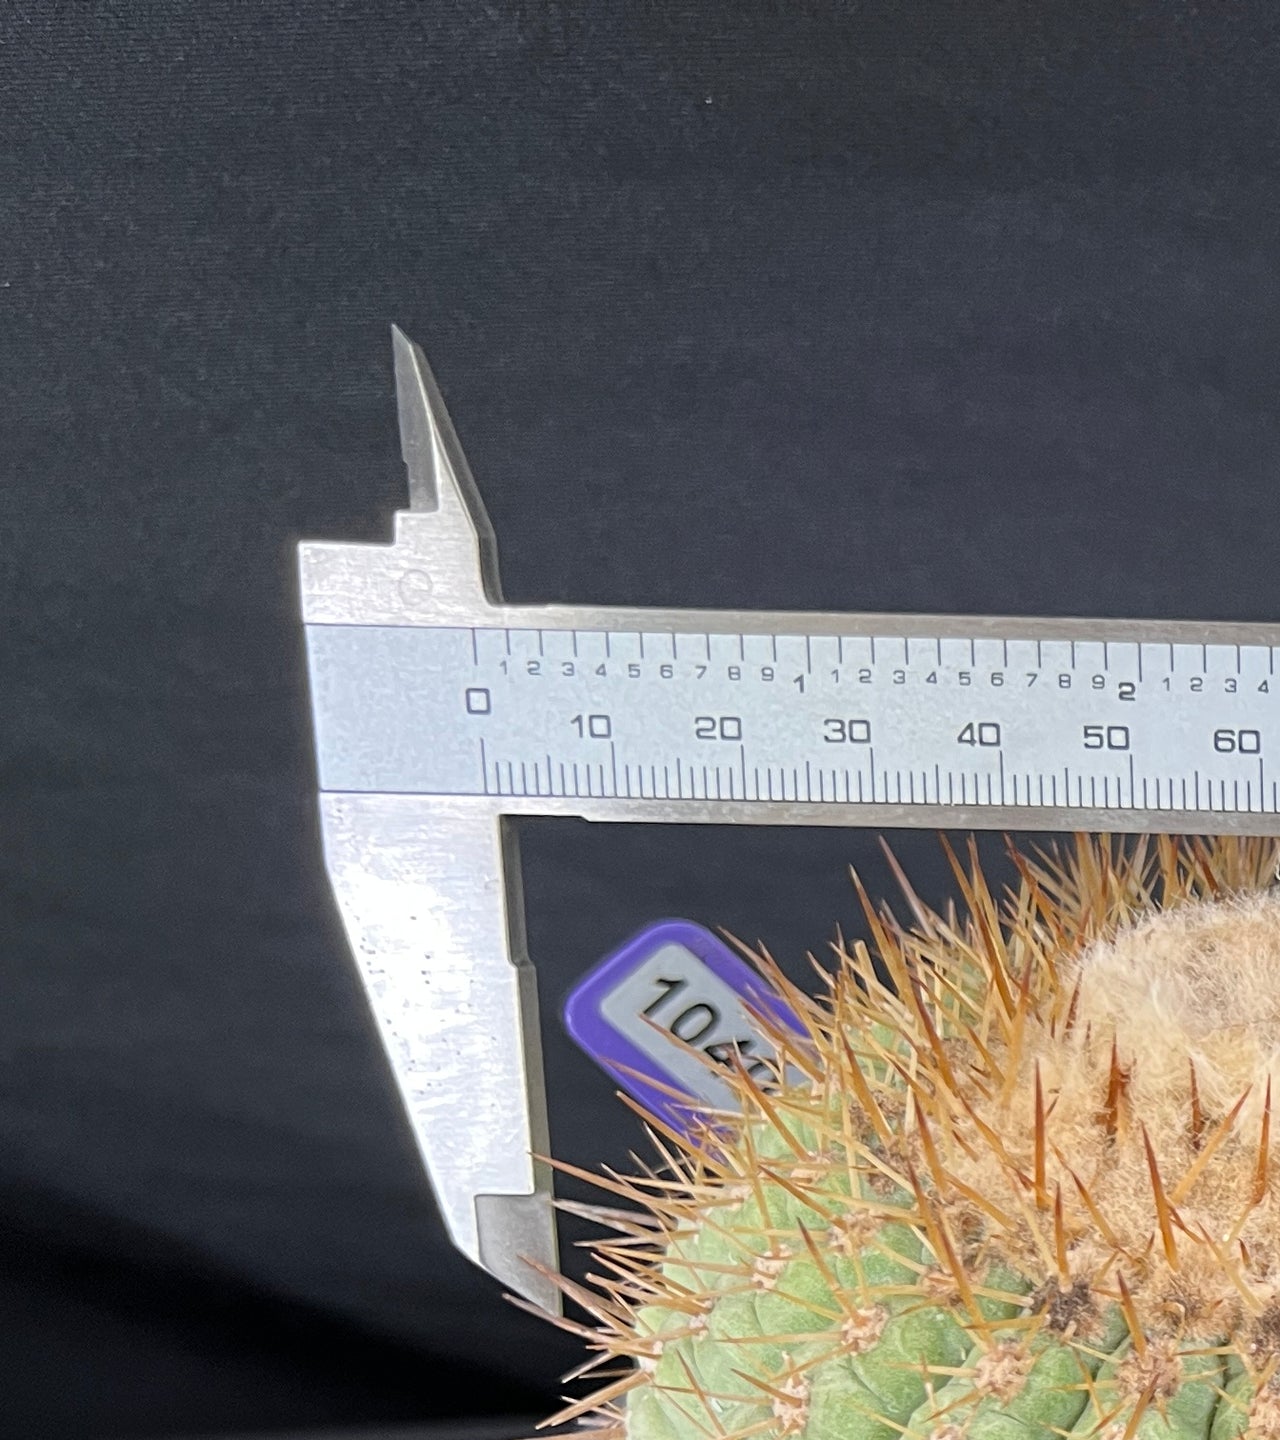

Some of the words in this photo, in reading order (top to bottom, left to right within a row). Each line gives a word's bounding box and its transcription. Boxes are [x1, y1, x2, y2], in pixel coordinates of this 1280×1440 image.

[499, 659, 508, 676] 1
[526, 660, 542, 676] 2
[561, 661, 575, 677] 3
[594, 663, 607, 678] 4
[627, 663, 641, 679] 5
[659, 664, 674, 680] 6
[695, 664, 708, 680] 7
[727, 665, 742, 681] 8
[760, 666, 775, 682] 9
[792, 673, 805, 694] 1
[830, 668, 839, 684] 1
[858, 668, 873, 684] 2
[892, 669, 906, 685] 3
[925, 670, 938, 685] 4
[958, 671, 972, 687] 5
[990, 671, 1005, 687] 6
[1025, 672, 1039, 688] 7
[1057, 673, 1072, 690] 8
[1091, 673, 1106, 690] 9
[1117, 681, 1136, 702] 2
[1162, 676, 1171, 692] 1
[1189, 676, 1204, 693] 2
[1224, 677, 1238, 694] 3
[1257, 679, 1270, 695] 4
[464, 687, 492, 716] 0
[570, 714, 612, 740] 10
[694, 716, 743, 742] 20
[823, 718, 872, 745] 30
[956, 721, 1001, 748] 40
[1083, 725, 1130, 751] 50
[1213, 728, 1261, 755] 60
